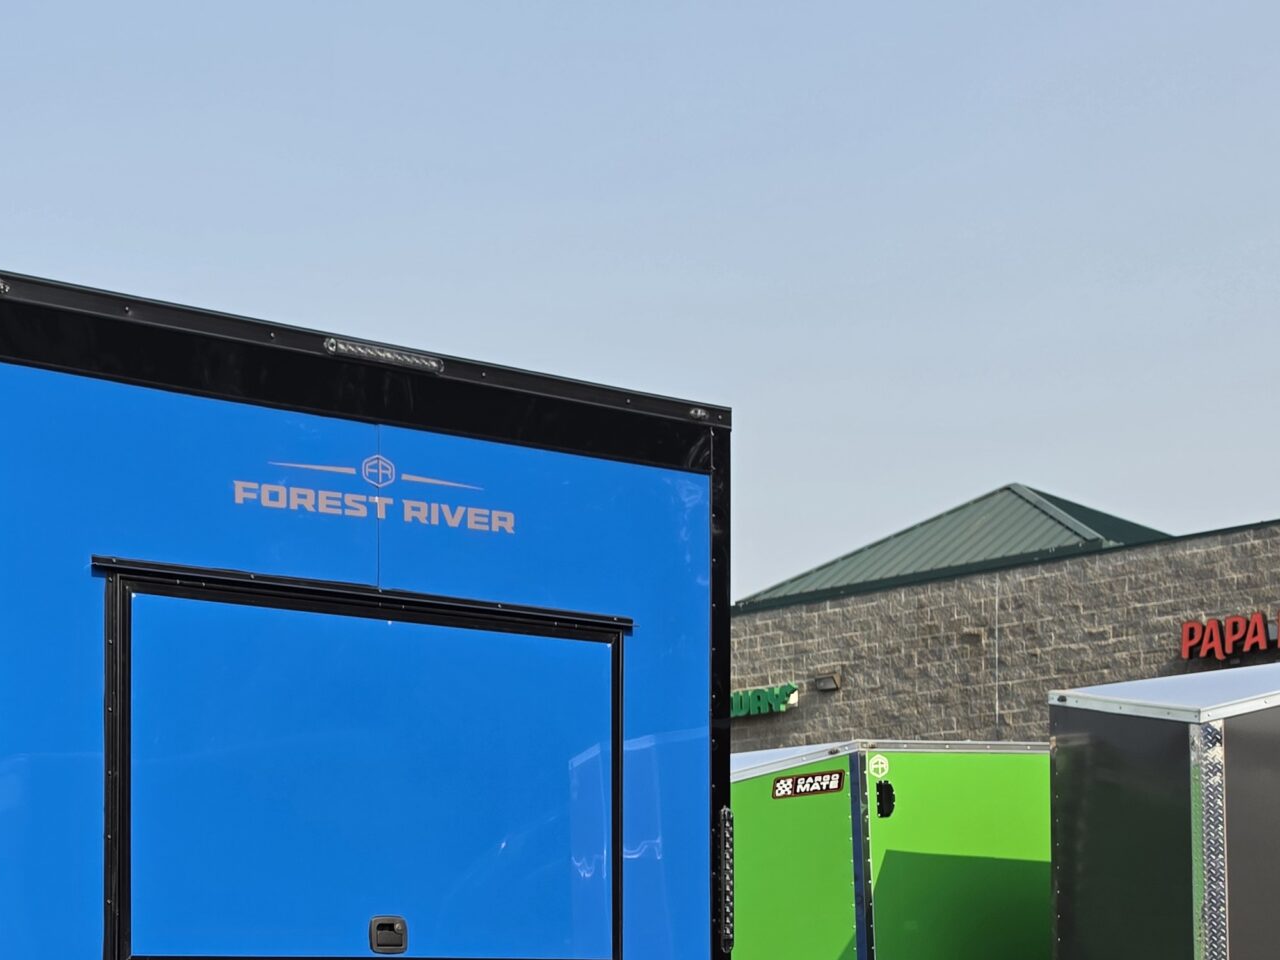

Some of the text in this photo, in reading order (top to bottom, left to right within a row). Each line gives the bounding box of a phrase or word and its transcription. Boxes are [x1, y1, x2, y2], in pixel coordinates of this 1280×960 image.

[233, 480, 515, 534] FOREST RIVER
[1181, 611, 1267, 660] PAPA
[796, 780, 839, 793] MATE
[797, 773, 840, 785] CARGO
